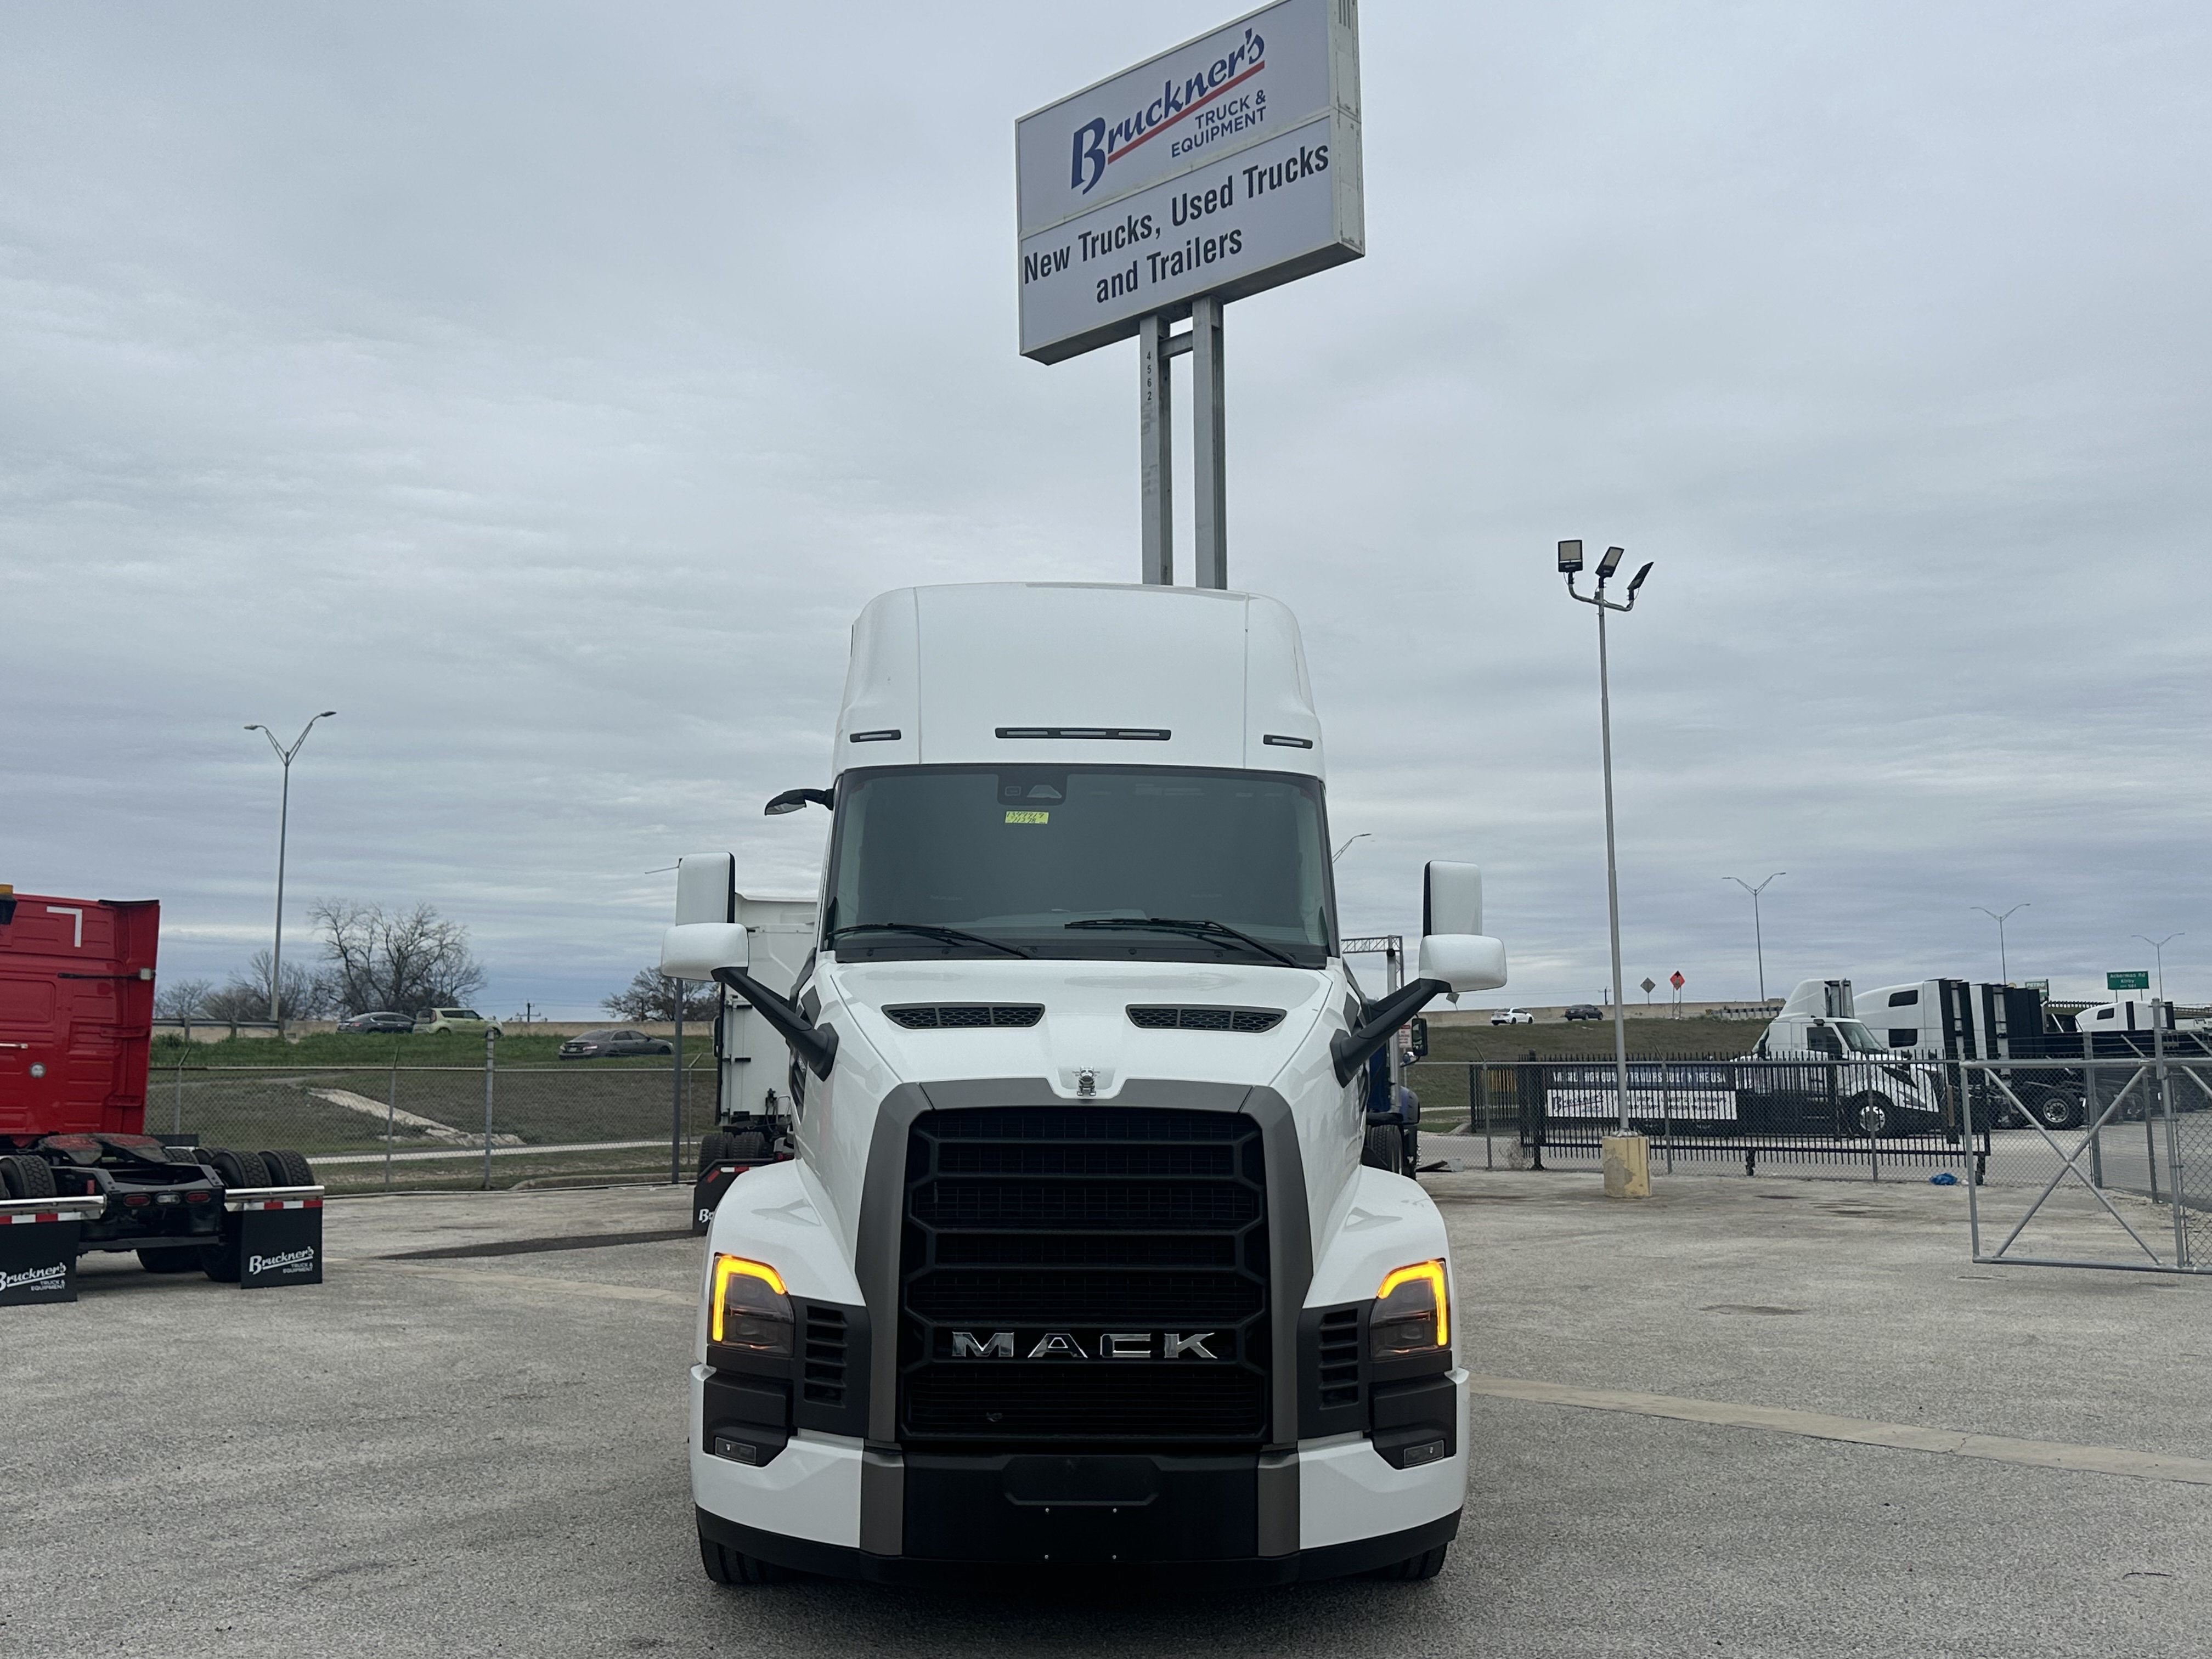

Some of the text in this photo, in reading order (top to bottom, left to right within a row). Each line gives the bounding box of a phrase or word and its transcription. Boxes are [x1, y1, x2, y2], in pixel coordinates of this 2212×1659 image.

[1071, 28, 1265, 195] Bruckner's
[1171, 106, 1267, 158] EQUIPMENT
[1195, 89, 1266, 130] TRUCK &
[1024, 145, 1329, 284] New Trucks, Used Trucks
[1097, 229, 1243, 303] and Trailers
[249, 1246, 314, 1275] Bruckner's
[952, 1331, 1218, 1359] MACK
